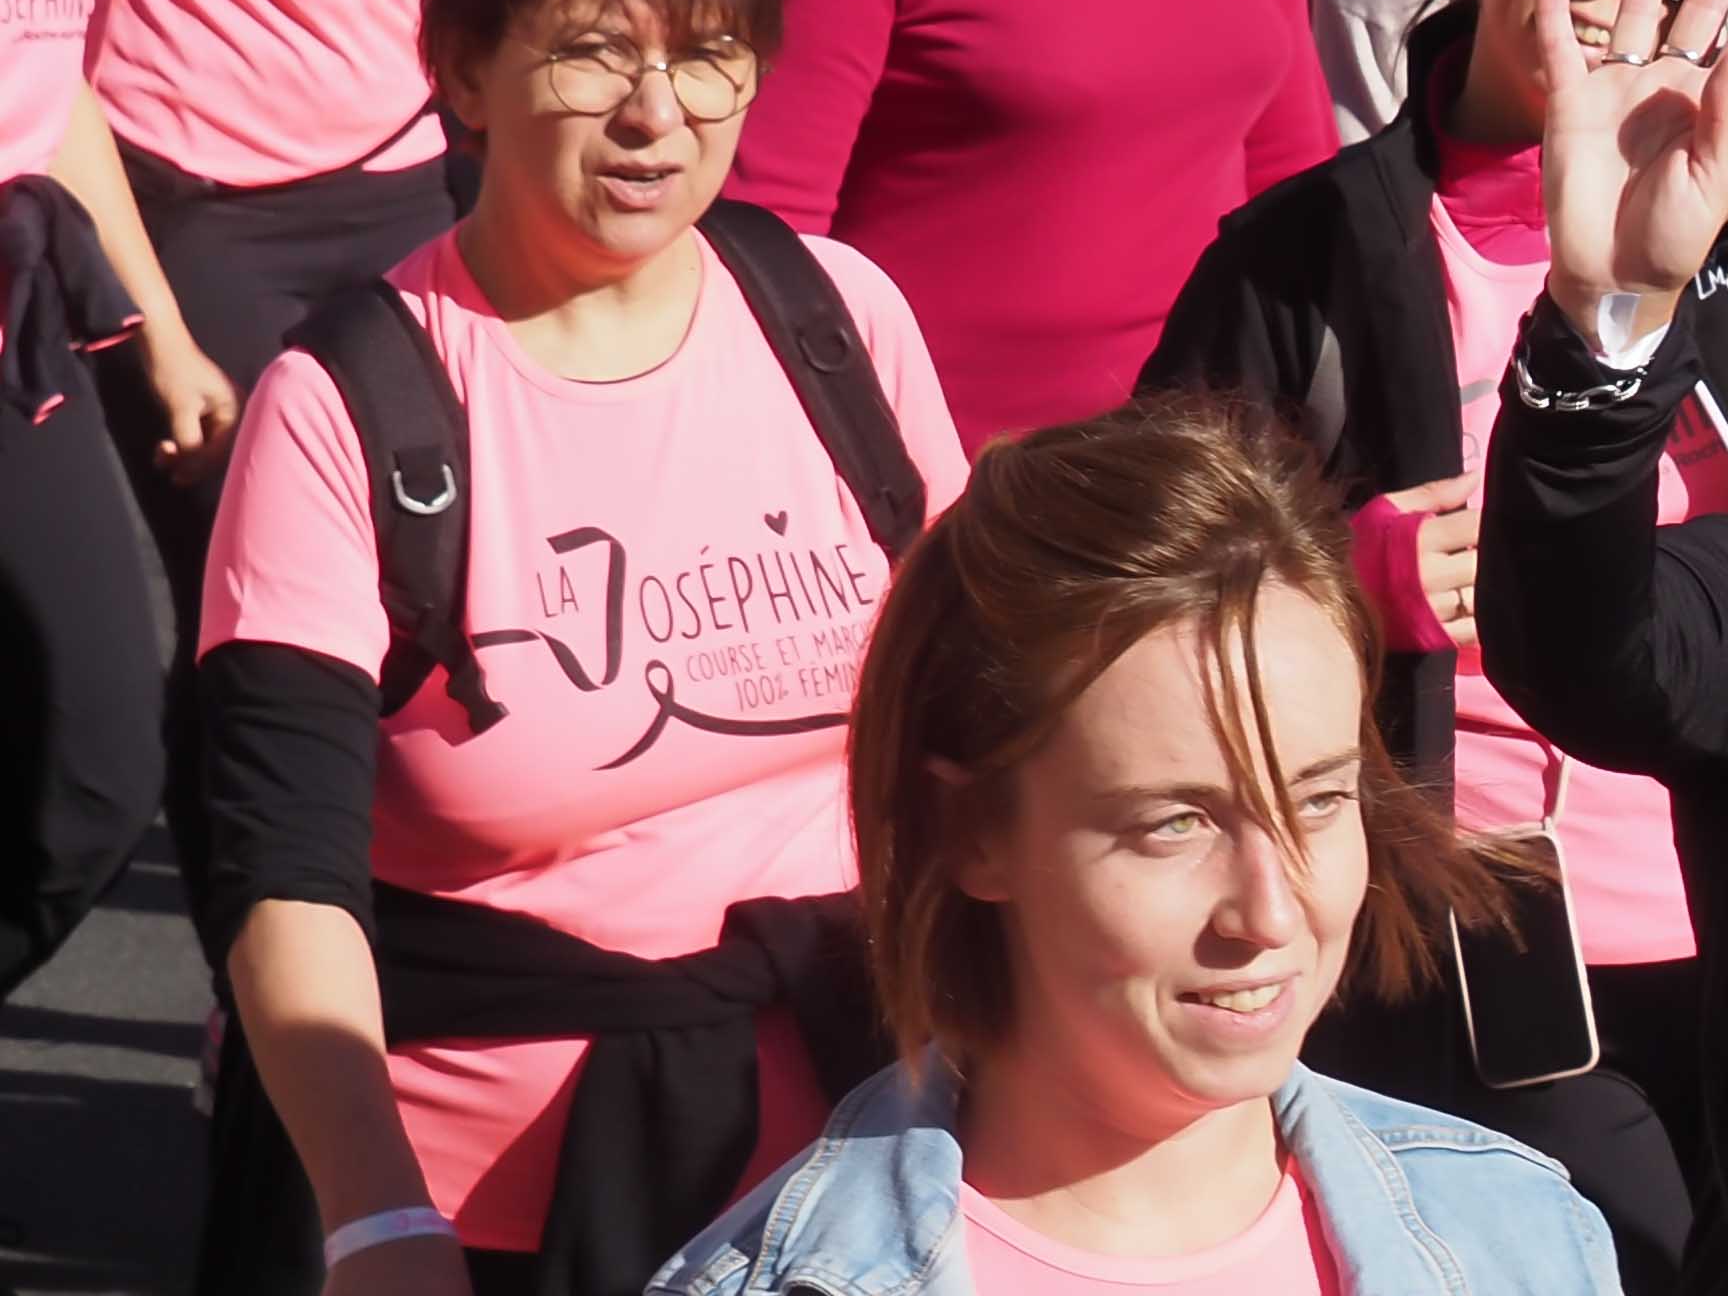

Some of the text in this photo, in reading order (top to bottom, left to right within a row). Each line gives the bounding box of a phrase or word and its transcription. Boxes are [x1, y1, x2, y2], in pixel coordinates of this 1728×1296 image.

[537, 565, 580, 618] LA
[687, 641, 767, 682] COURSE
[776, 635, 802, 667] ET
[735, 675, 790, 713] 100%
